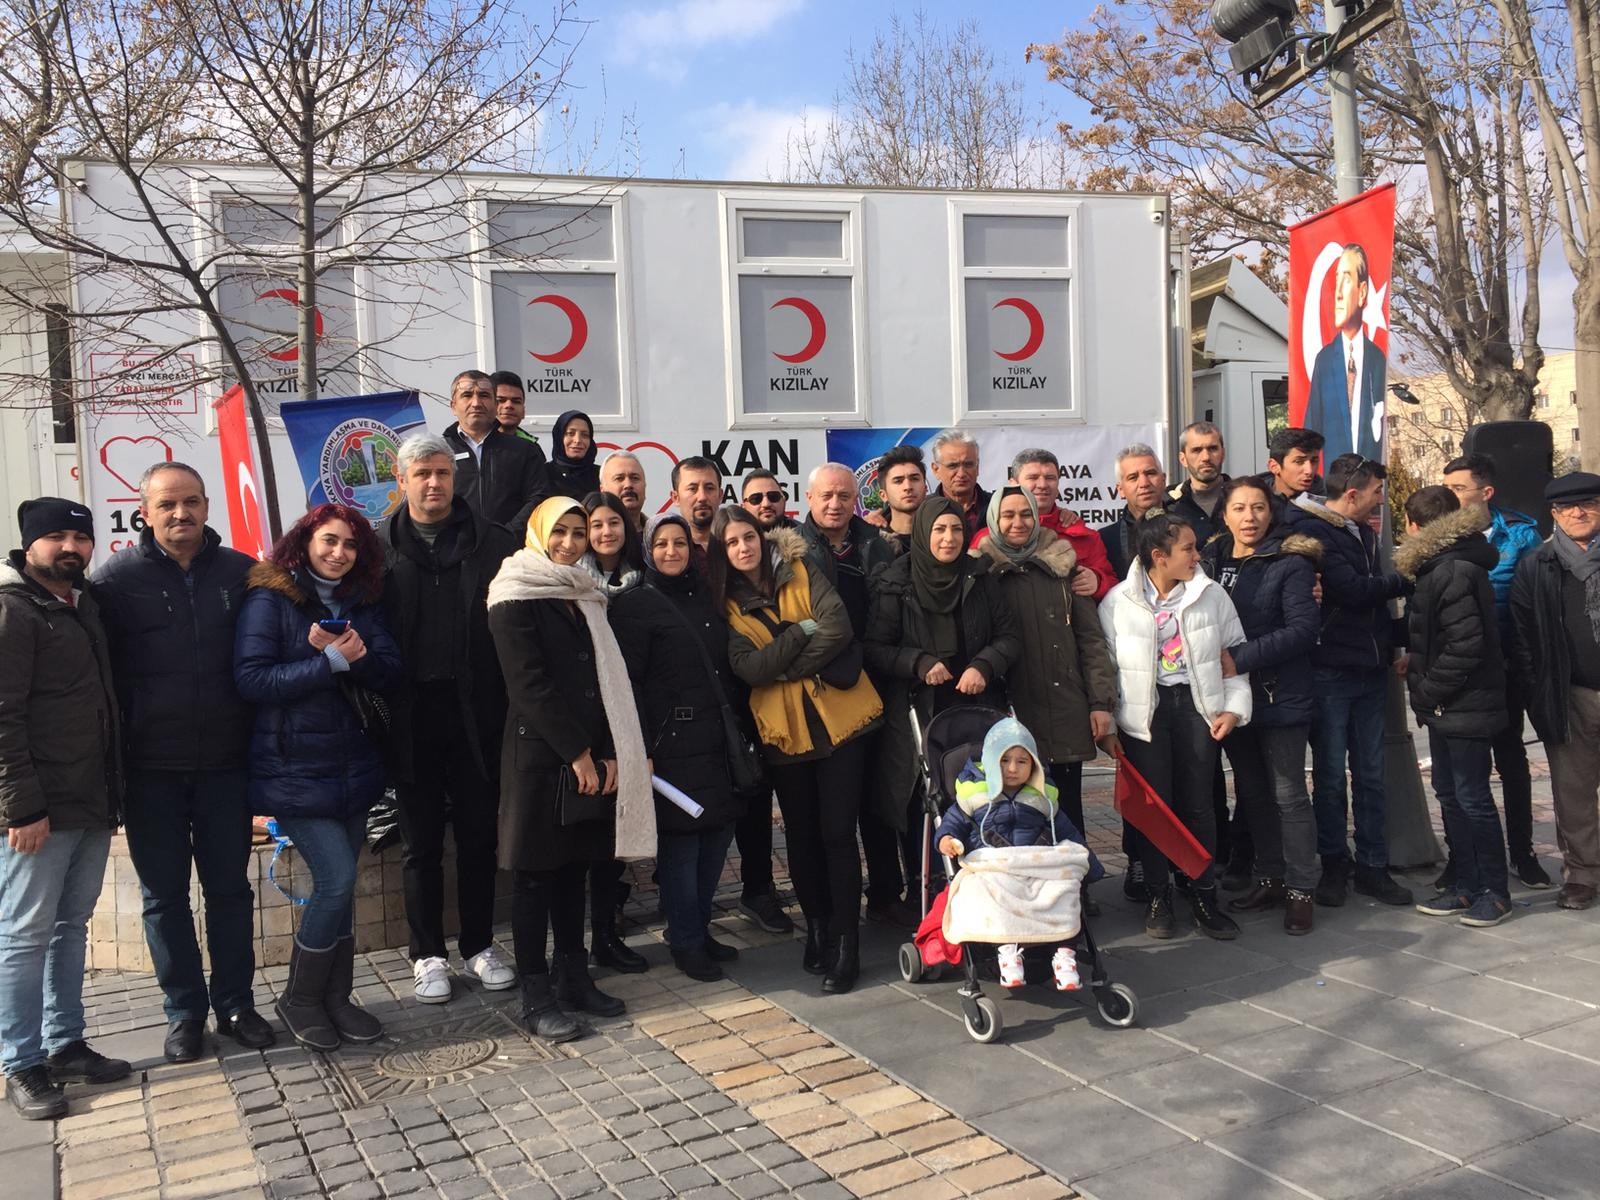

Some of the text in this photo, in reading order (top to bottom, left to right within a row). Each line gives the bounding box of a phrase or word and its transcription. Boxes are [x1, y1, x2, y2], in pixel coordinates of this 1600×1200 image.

[544, 366, 574, 377] TÜRK
[786, 365, 813, 376] TÜRK
[1007, 364, 1033, 375] TÜRK
[527, 378, 592, 393] KIZILAY
[770, 377, 829, 391] KIZILAY
[992, 376, 1048, 390] KIZILAY
[357, 420, 370, 428] VE
[702, 439, 799, 477] KAN
